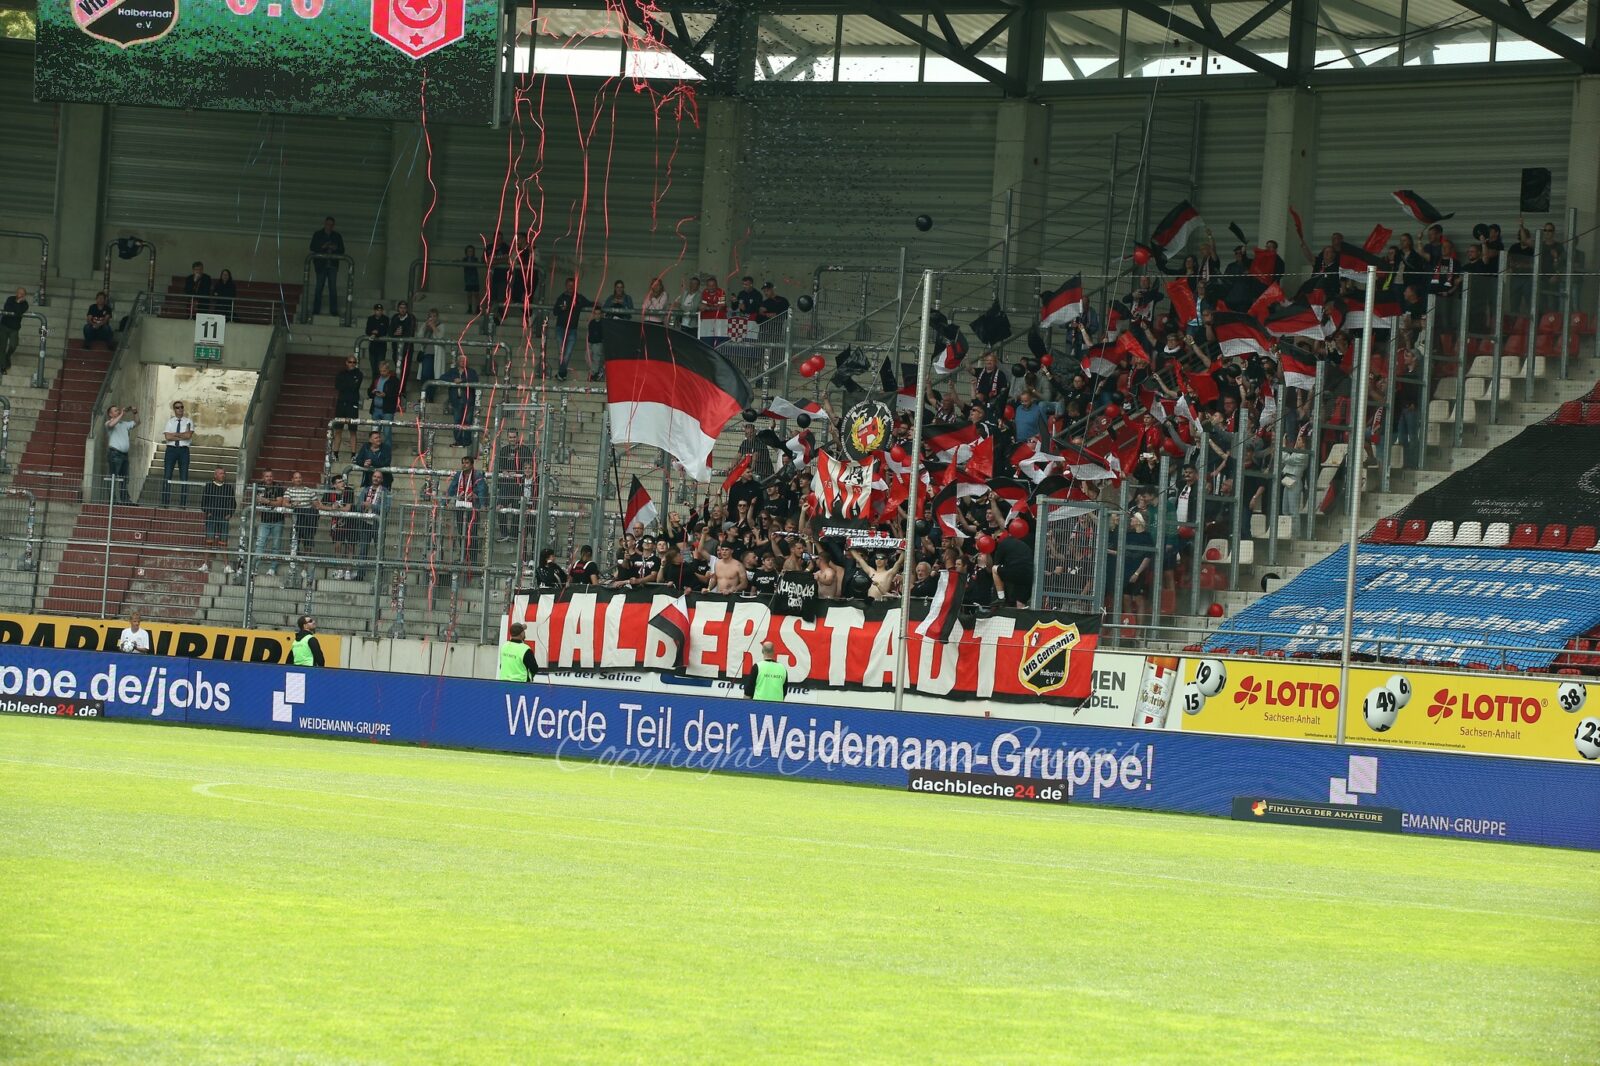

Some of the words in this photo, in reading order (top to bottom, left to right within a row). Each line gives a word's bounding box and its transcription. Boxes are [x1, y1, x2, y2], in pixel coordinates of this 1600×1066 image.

[118, 7, 173, 18] Halberstadt
[201, 320, 218, 339] 11
[511, 594, 1016, 697] HALBERSTADT
[1022, 659, 1038, 677] VfB
[1036, 632, 1076, 665] Germania
[598, 671, 642, 682] Saline
[1196, 661, 1212, 685] 19
[1184, 693, 1200, 711] 15
[1265, 680, 1340, 710] LOTTO
[1376, 691, 1396, 712] 49
[1560, 688, 1581, 711] 38
[1264, 711, 1321, 725] Sachsen-Anhalt
[1461, 693, 1542, 724] LOTTO
[299, 716, 392, 736] WEIDEMANN-GRUPPE
[1460, 726, 1521, 740] Sachsen-Anhalt
[505, 693, 607, 744] Werde
[619, 703, 672, 749] Teil
[684, 709, 739, 754] der
[749, 712, 1154, 798] Weidemann-Gruppe!
[1268, 804, 1312, 815] FINALTAG
[1314, 809, 1332, 817] DER
[1334, 811, 1383, 821] AMATEURE
[1401, 812, 1507, 837] EMANN-GRUPPE
